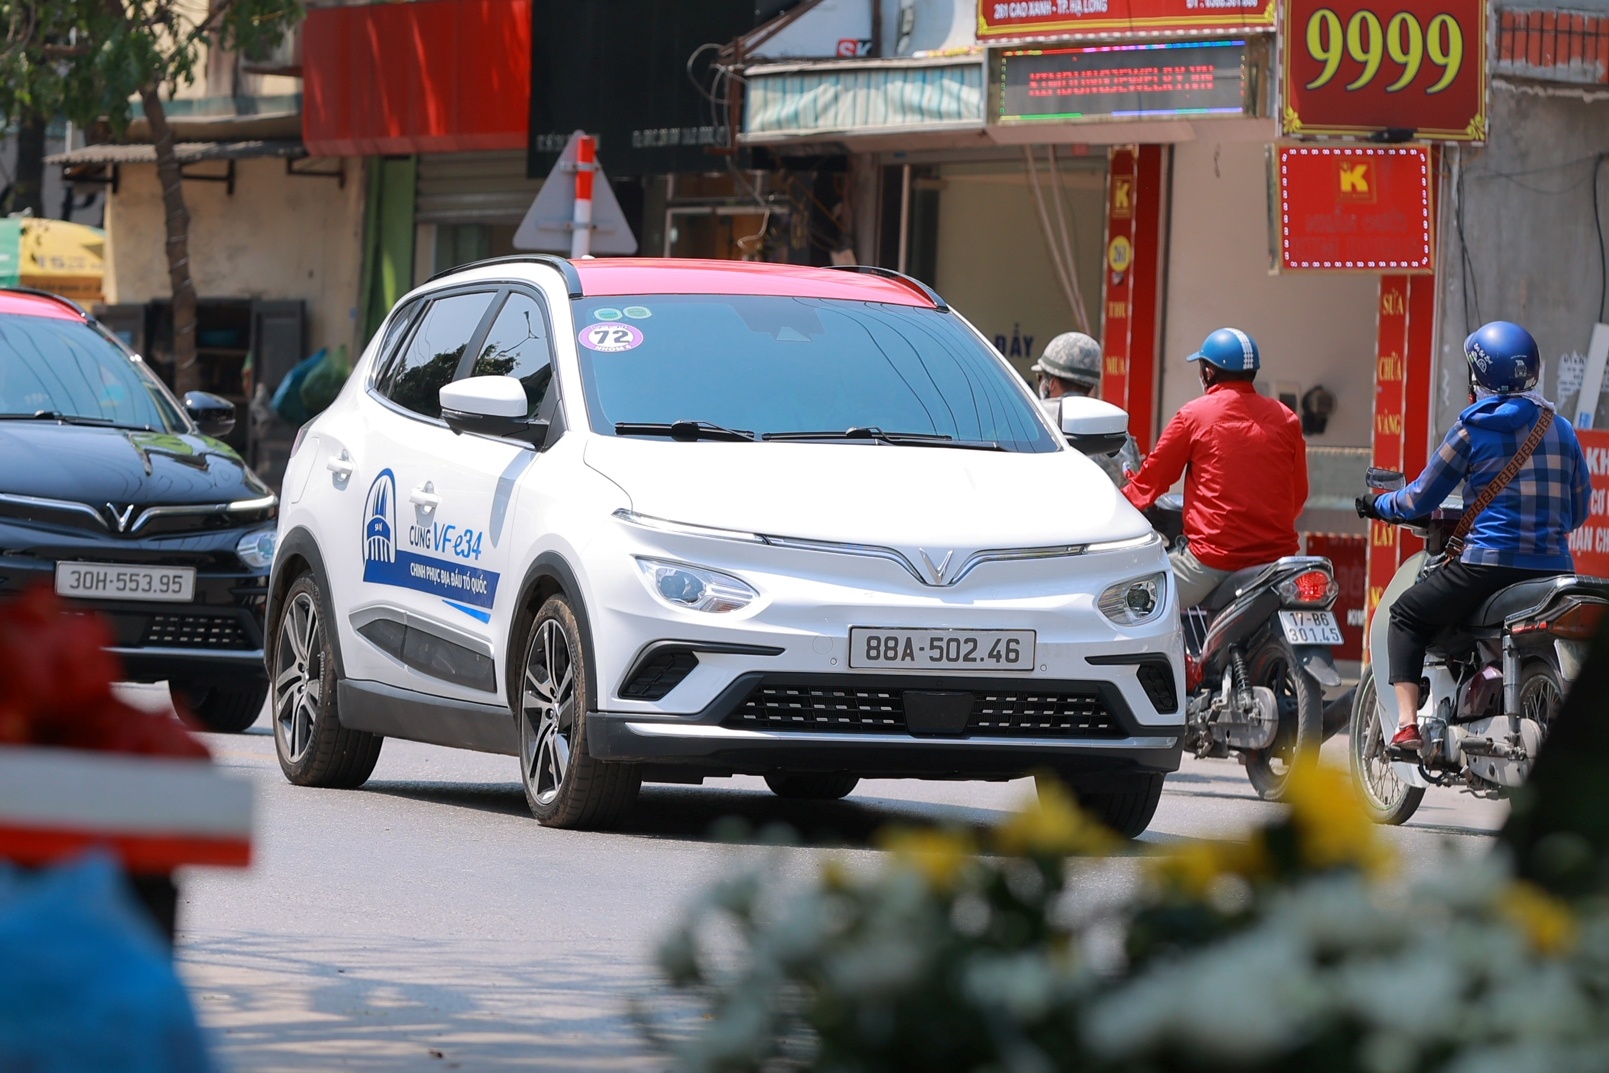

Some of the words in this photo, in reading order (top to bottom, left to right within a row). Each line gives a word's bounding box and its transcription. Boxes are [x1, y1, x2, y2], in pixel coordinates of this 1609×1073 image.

[1009, 2, 1028, 18] CAO
[1083, 0, 1108, 13] LONG
[1306, 7, 1464, 95] 9999
[1339, 162, 1369, 192] K
[594, 329, 631, 345] 72
[69, 570, 183, 594] 30H-553.95
[410, 562, 426, 579] CHINH
[426, 566, 440, 586] PHỤC
[440, 569, 451, 589] ĐỊA
[471, 574, 488, 595] QUỐC
[865, 635, 1021, 664] 88A-502.46
